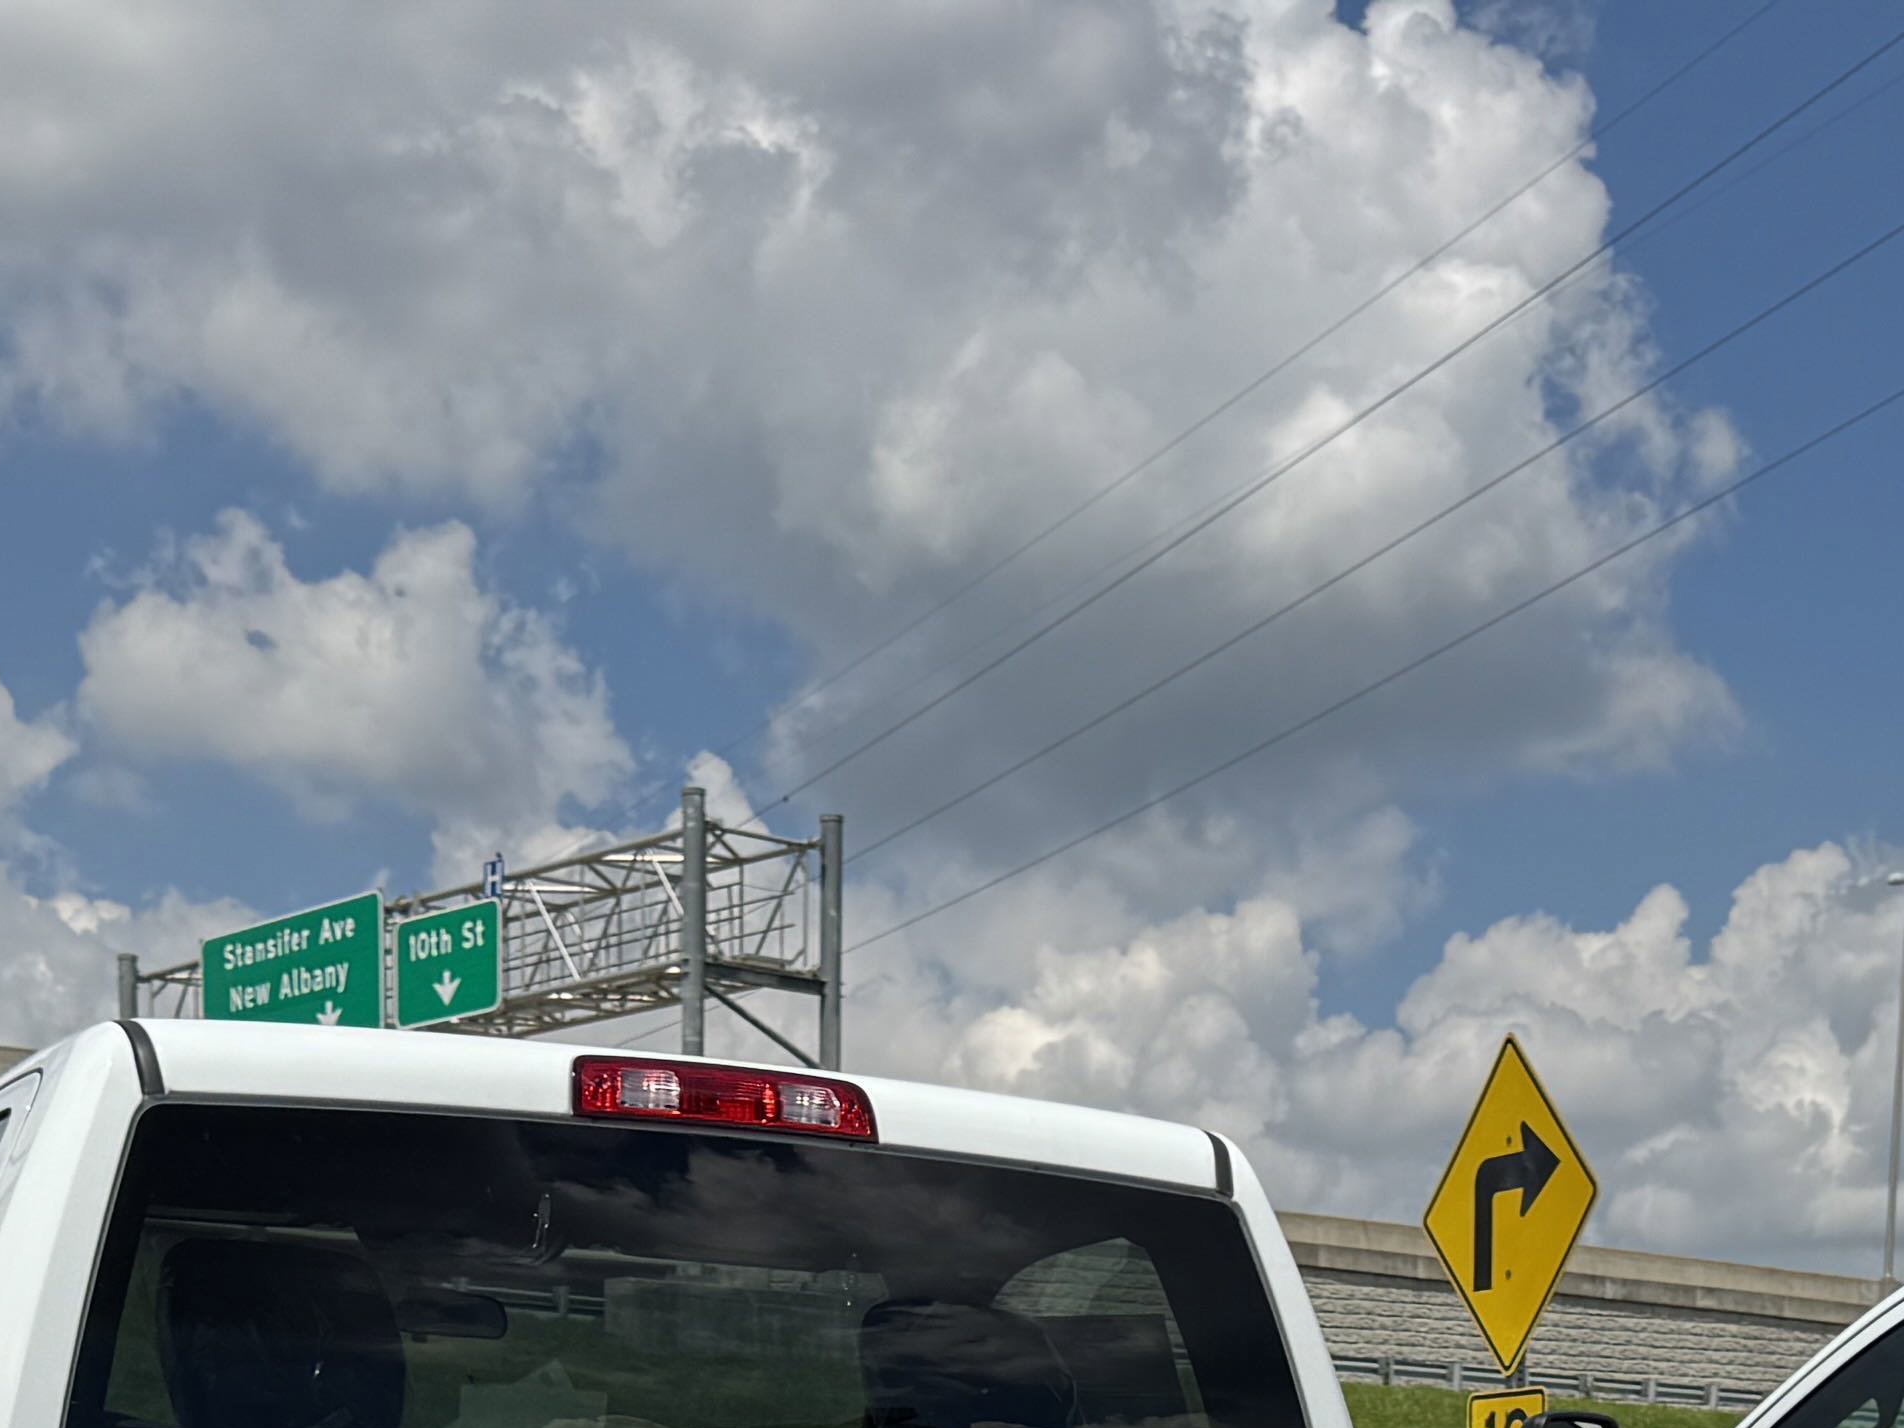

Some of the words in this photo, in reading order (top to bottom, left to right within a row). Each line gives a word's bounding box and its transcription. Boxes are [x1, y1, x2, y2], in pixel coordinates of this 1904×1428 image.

[223, 928, 311, 971] Stansifer
[318, 917, 356, 945] Ave
[408, 928, 453, 962] 10th
[461, 919, 485, 949] St
[229, 981, 271, 1013] New
[278, 961, 350, 1000] Albany
